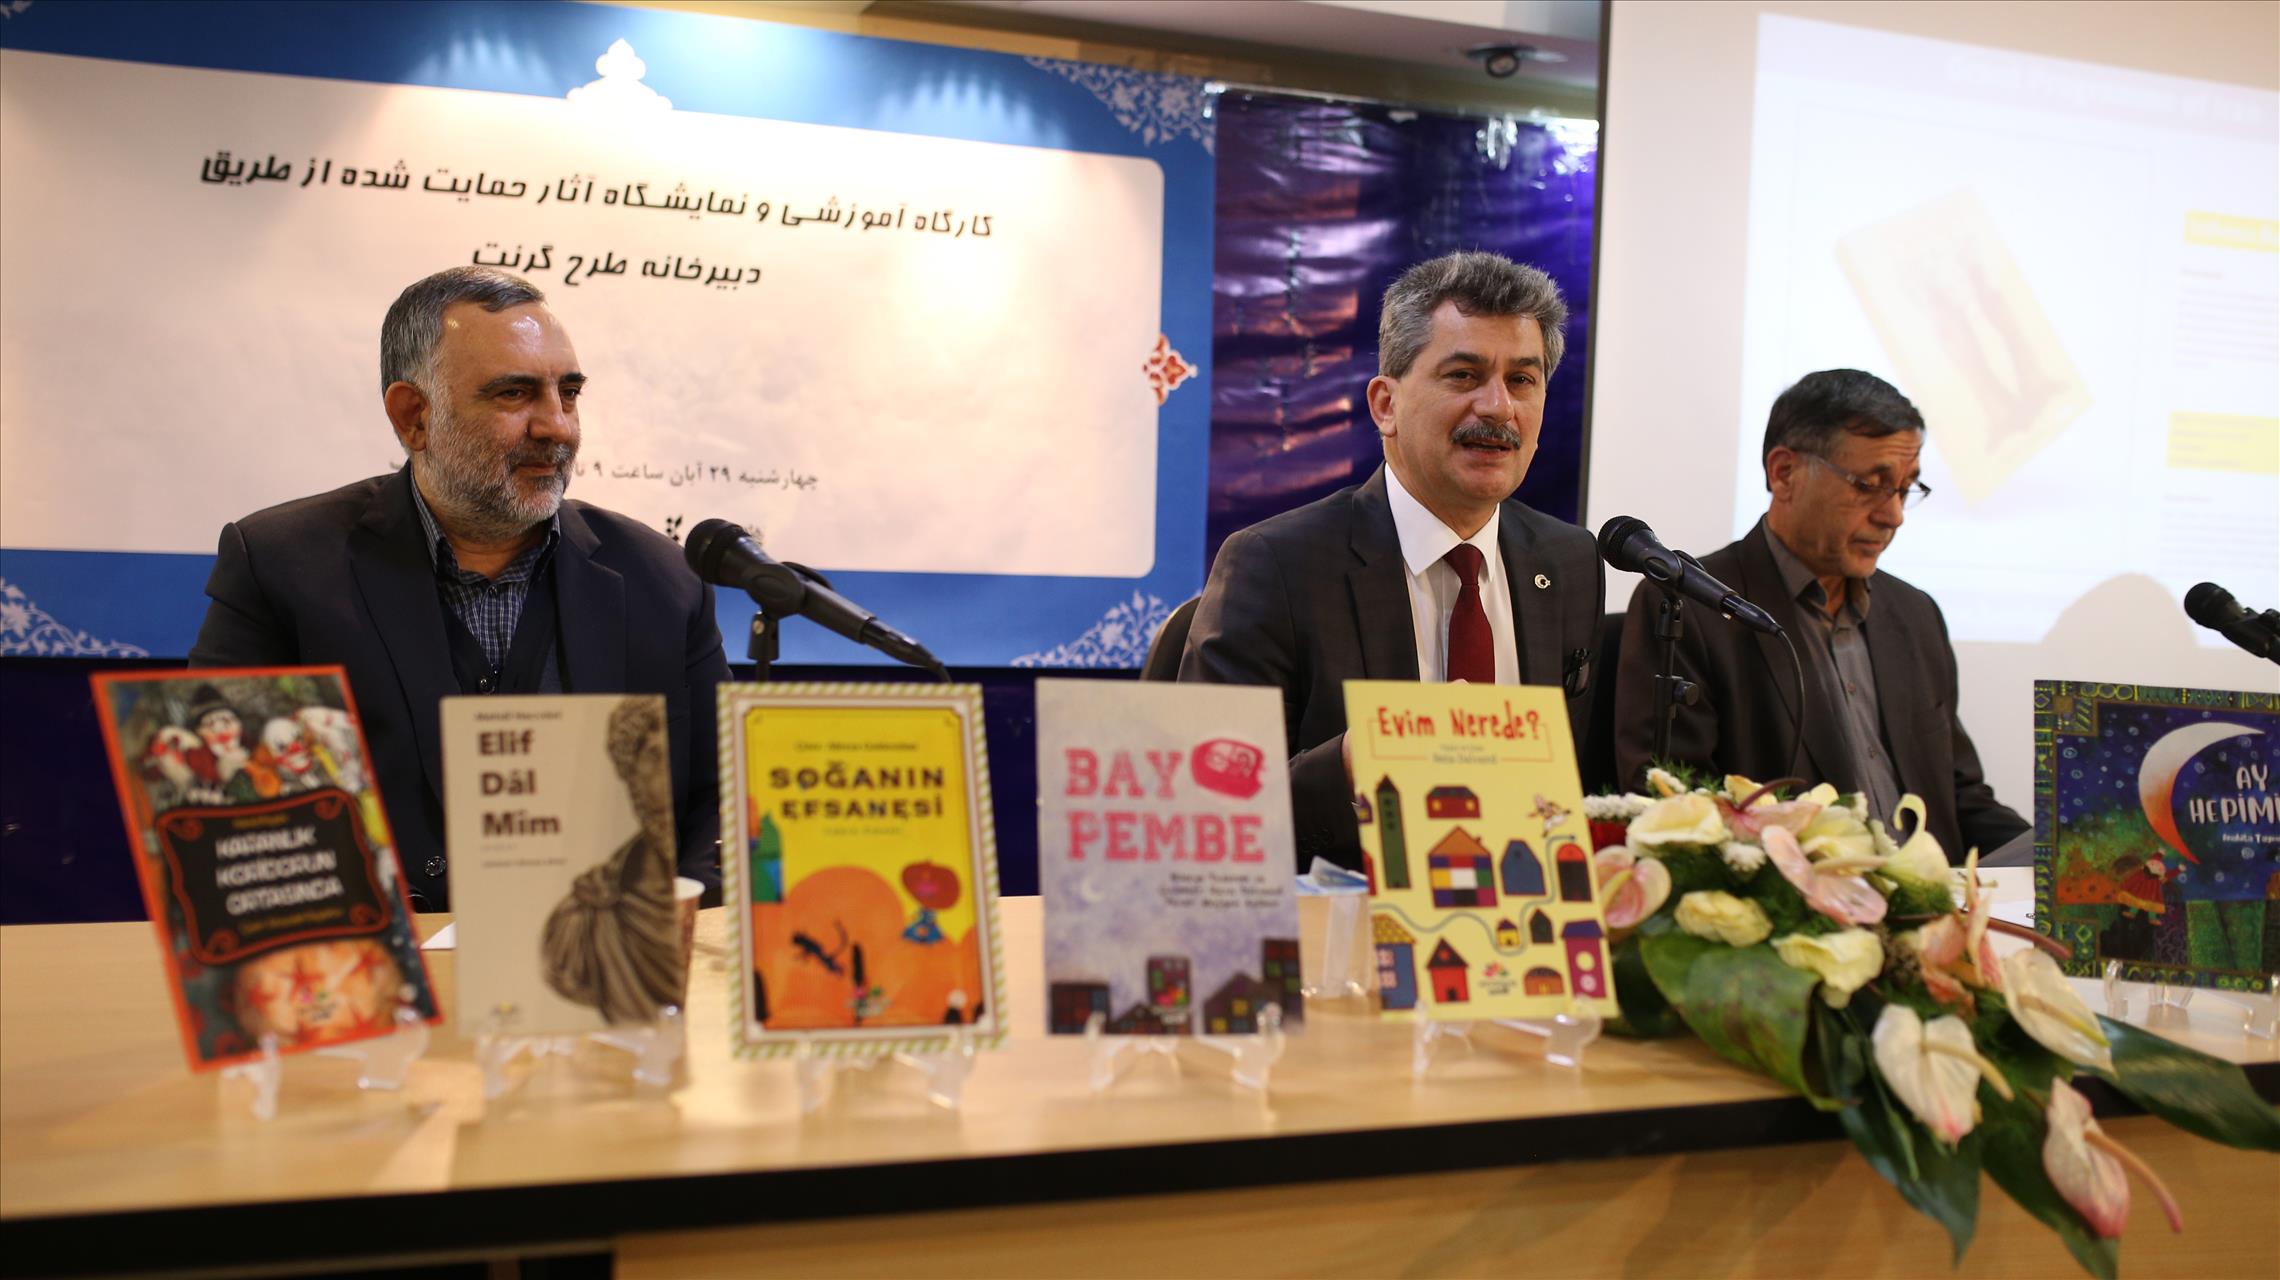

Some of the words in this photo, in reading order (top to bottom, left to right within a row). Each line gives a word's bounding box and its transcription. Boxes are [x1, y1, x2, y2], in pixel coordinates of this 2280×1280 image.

[200, 150, 293, 187] طریق
[299, 158, 333, 189] از
[340, 159, 411, 190] شده
[422, 168, 527, 203] حمایت
[536, 174, 594, 205] آثار
[603, 183, 747, 220] نمایشگاه
[756, 201, 770, 223] و
[780, 196, 905, 231] آموزشی
[913, 207, 994, 238] کارگاه
[471, 242, 554, 274] گرنت
[563, 250, 628, 287] طرح
[641, 255, 762, 291] دبیرخانه
[611, 463, 664, 480] ساعت
[669, 460, 703, 488] آبان
[738, 468, 819, 491] چهارشنبه
[1377, 705, 1435, 738] Evim
[1448, 699, 1540, 741] Nerede?
[478, 728, 535, 755] Elif
[769, 759, 944, 791] SOĞANIN
[1064, 747, 1183, 799] BAY
[2235, 763, 2269, 792] AY
[781, 793, 943, 821] EFSANESİ
[1066, 811, 1265, 864] PEMBE
